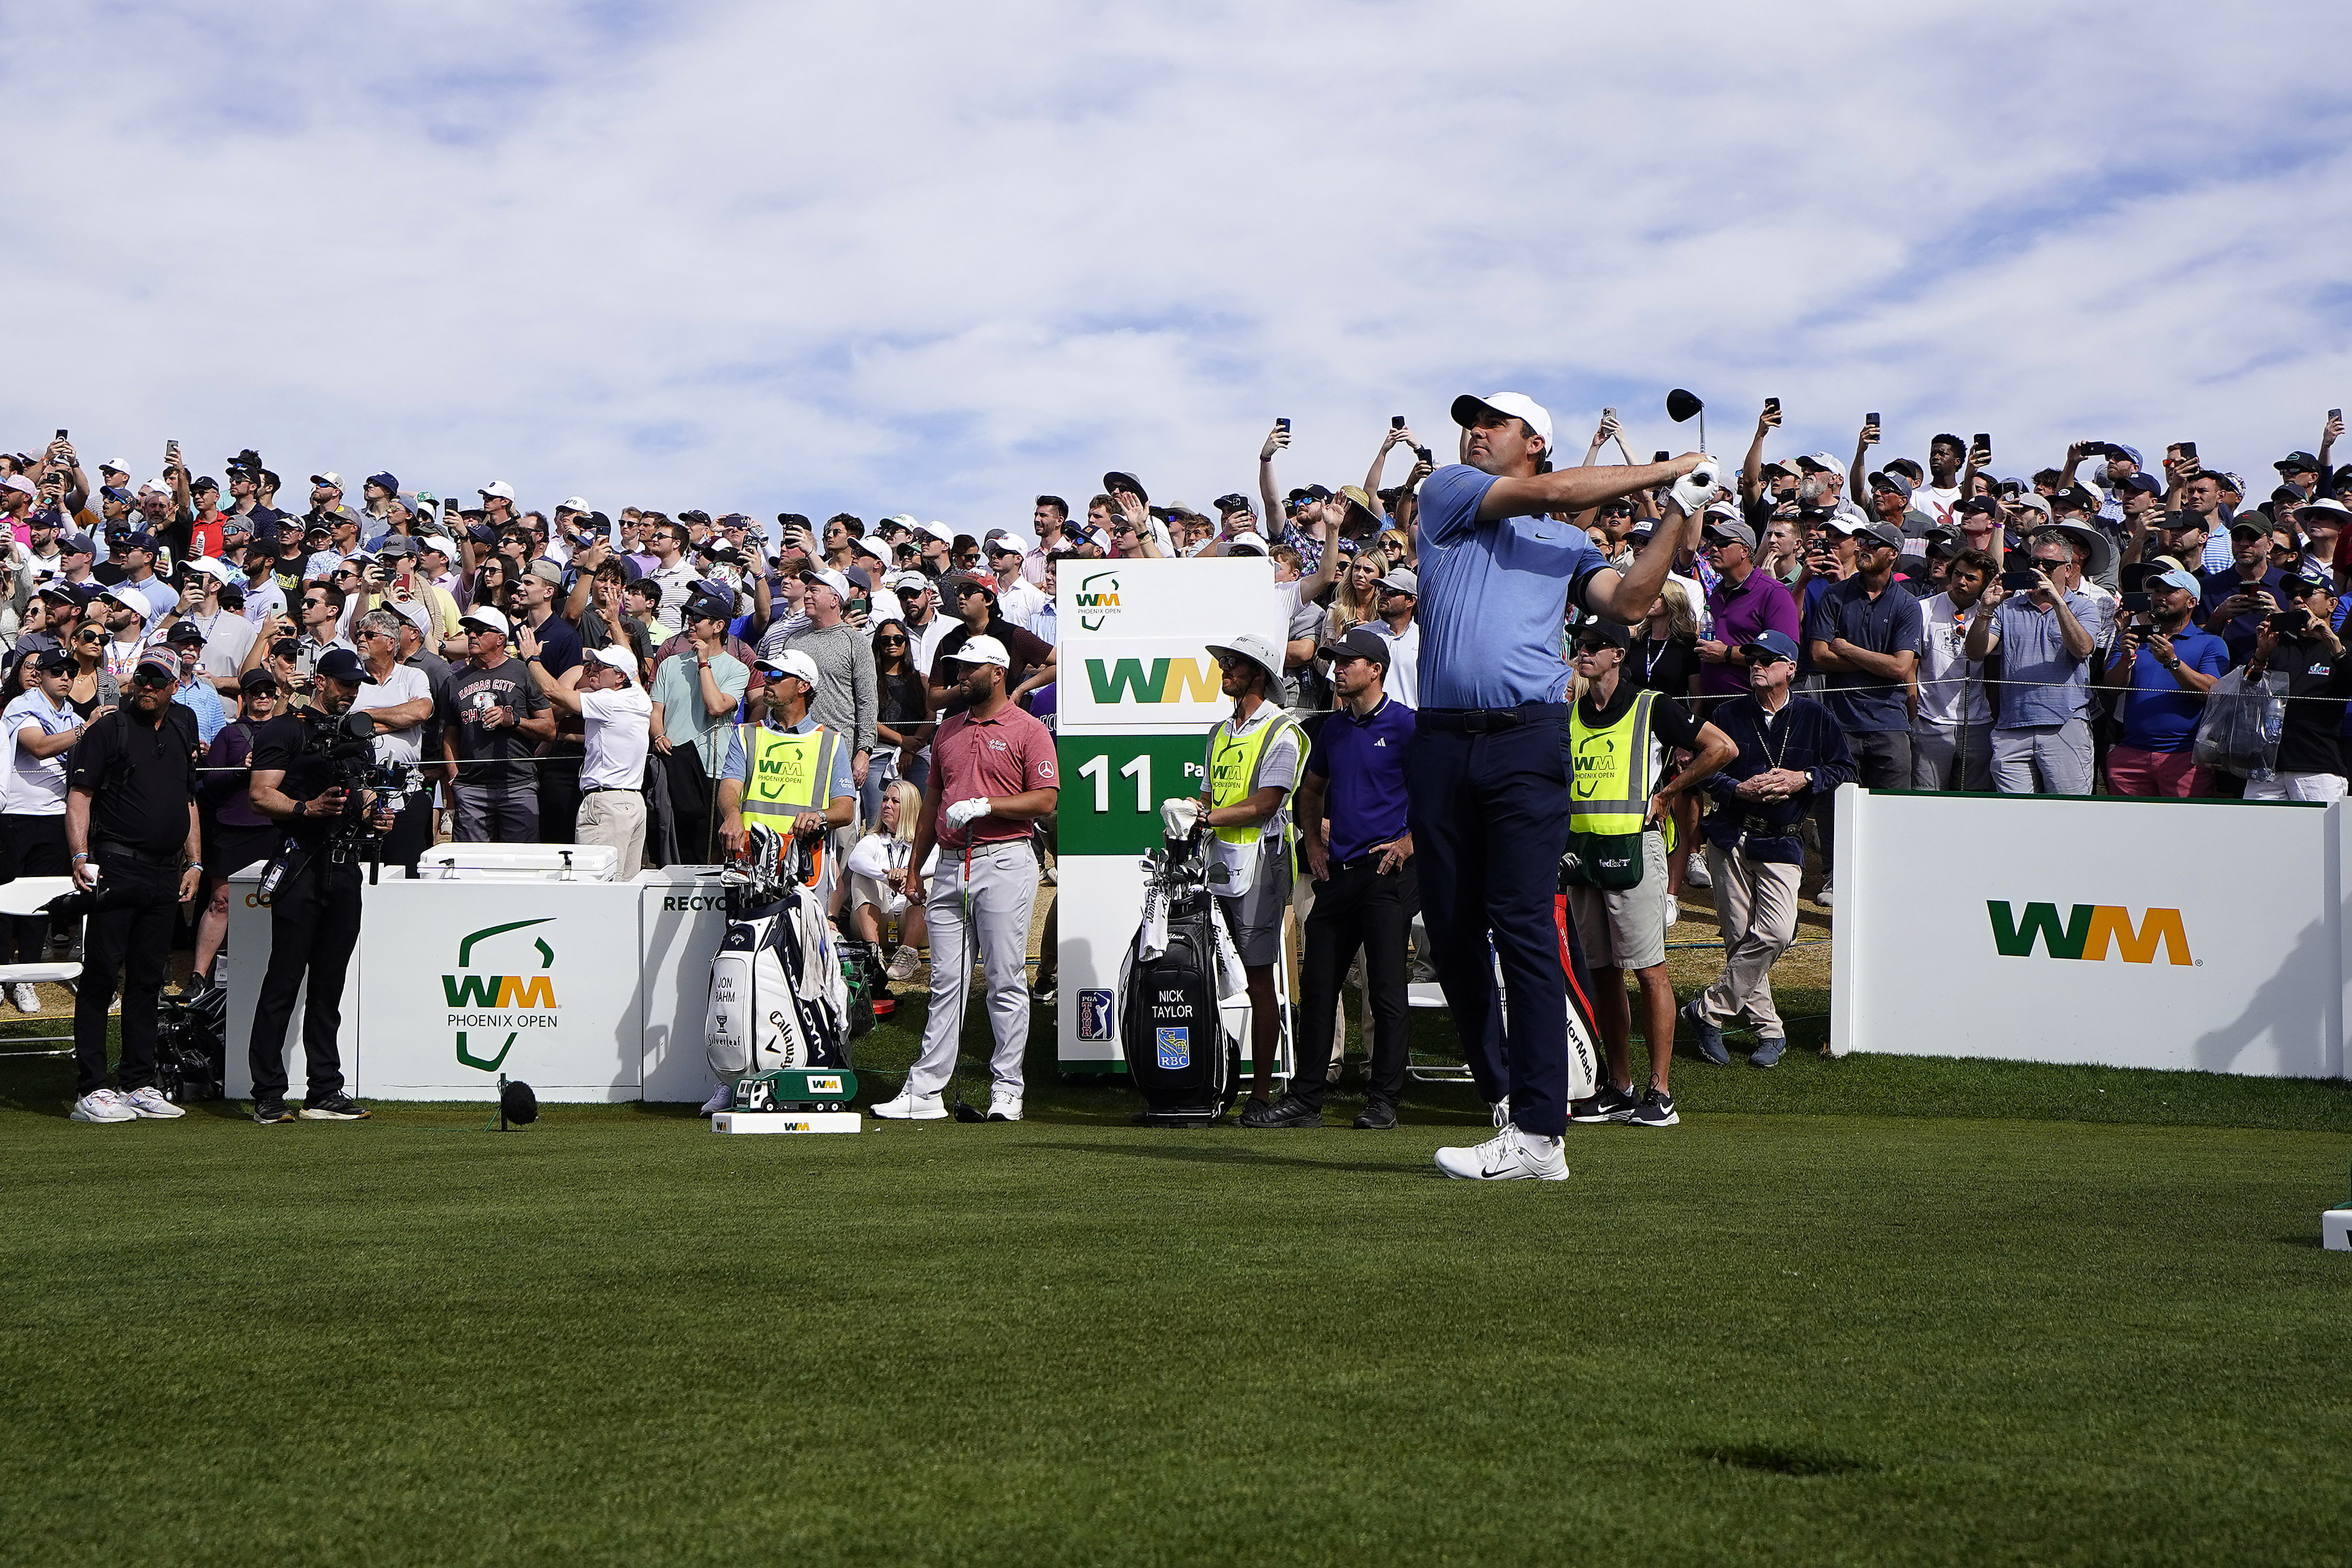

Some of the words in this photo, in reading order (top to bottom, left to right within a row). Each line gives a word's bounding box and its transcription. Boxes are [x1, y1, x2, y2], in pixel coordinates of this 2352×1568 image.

[1076, 593, 1120, 606] WM
[458, 679, 491, 701] KANSAS
[492, 678, 516, 693] CITY
[759, 760, 802, 776] WM
[1574, 755, 1615, 770] WM
[1077, 755, 1151, 813] 11
[1184, 762, 1204, 777] Pa
[664, 896, 726, 911] RECYC
[1986, 900, 2193, 966] WM
[717, 977, 732, 989] JON
[441, 975, 557, 1008] WM
[1159, 990, 1185, 1002] NICK
[1152, 1005, 1192, 1018] TAYLOR
[448, 1014, 513, 1027] PHOENIX
[517, 1015, 558, 1027] OPEN
[1082, 1002, 1092, 1037] TOUR
[707, 1033, 741, 1048] Silverleaf
[1566, 1018, 1592, 1086] lorMade
[1161, 1056, 1187, 1066] RBC
[812, 1080, 837, 1089] WM
[716, 1121, 727, 1131] WM
[784, 1122, 810, 1131] WM
